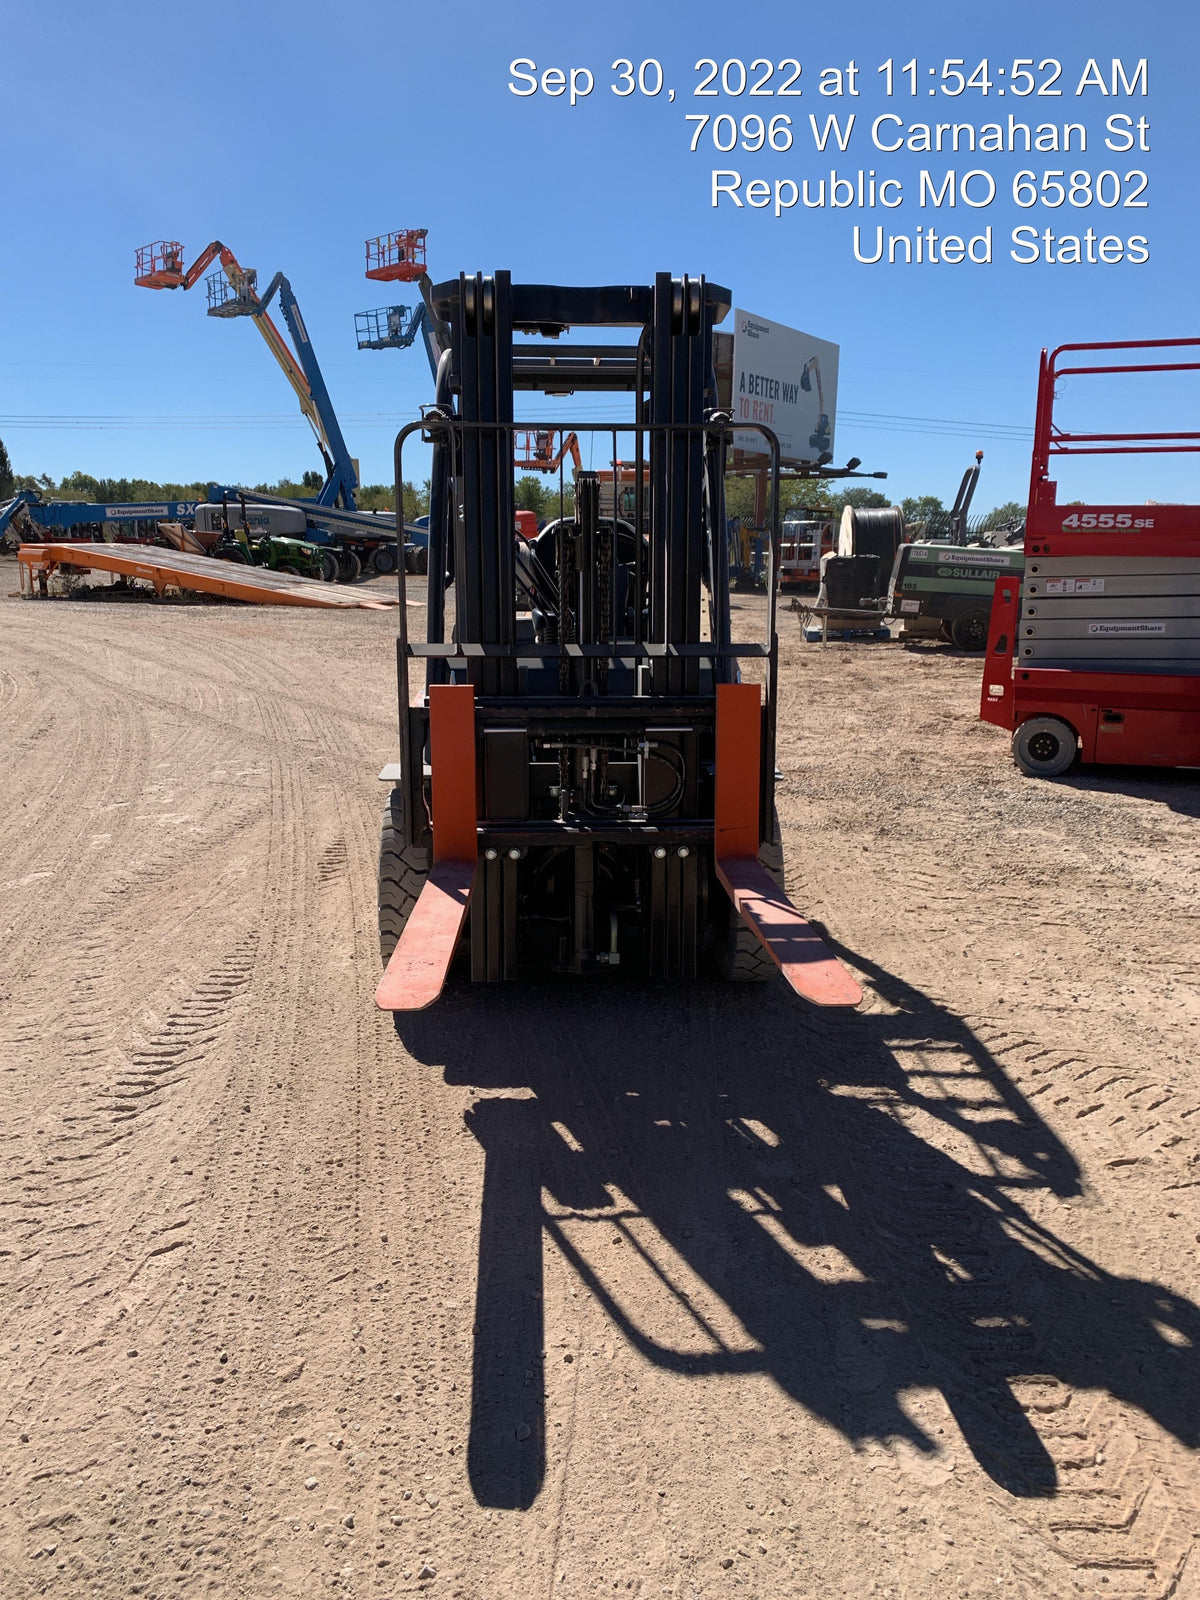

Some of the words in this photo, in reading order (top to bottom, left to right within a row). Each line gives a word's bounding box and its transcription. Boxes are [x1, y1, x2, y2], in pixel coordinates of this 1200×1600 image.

[747, 320, 770, 334] Equipment
[739, 372, 746, 393] A
[748, 374, 780, 401] BETTER
[782, 382, 799, 405] WAY
[738, 397, 749, 419] TO
[752, 400, 776, 425] RENT.
[117, 508, 164, 516] EquipmentShare
[176, 503, 196, 516] SX
[1062, 513, 1133, 528] 4555
[1133, 518, 1155, 528] SE
[951, 554, 1005, 564] EquipmentShare
[952, 567, 1000, 580] SULLAIR
[1099, 624, 1163, 633] EquipmentShare
